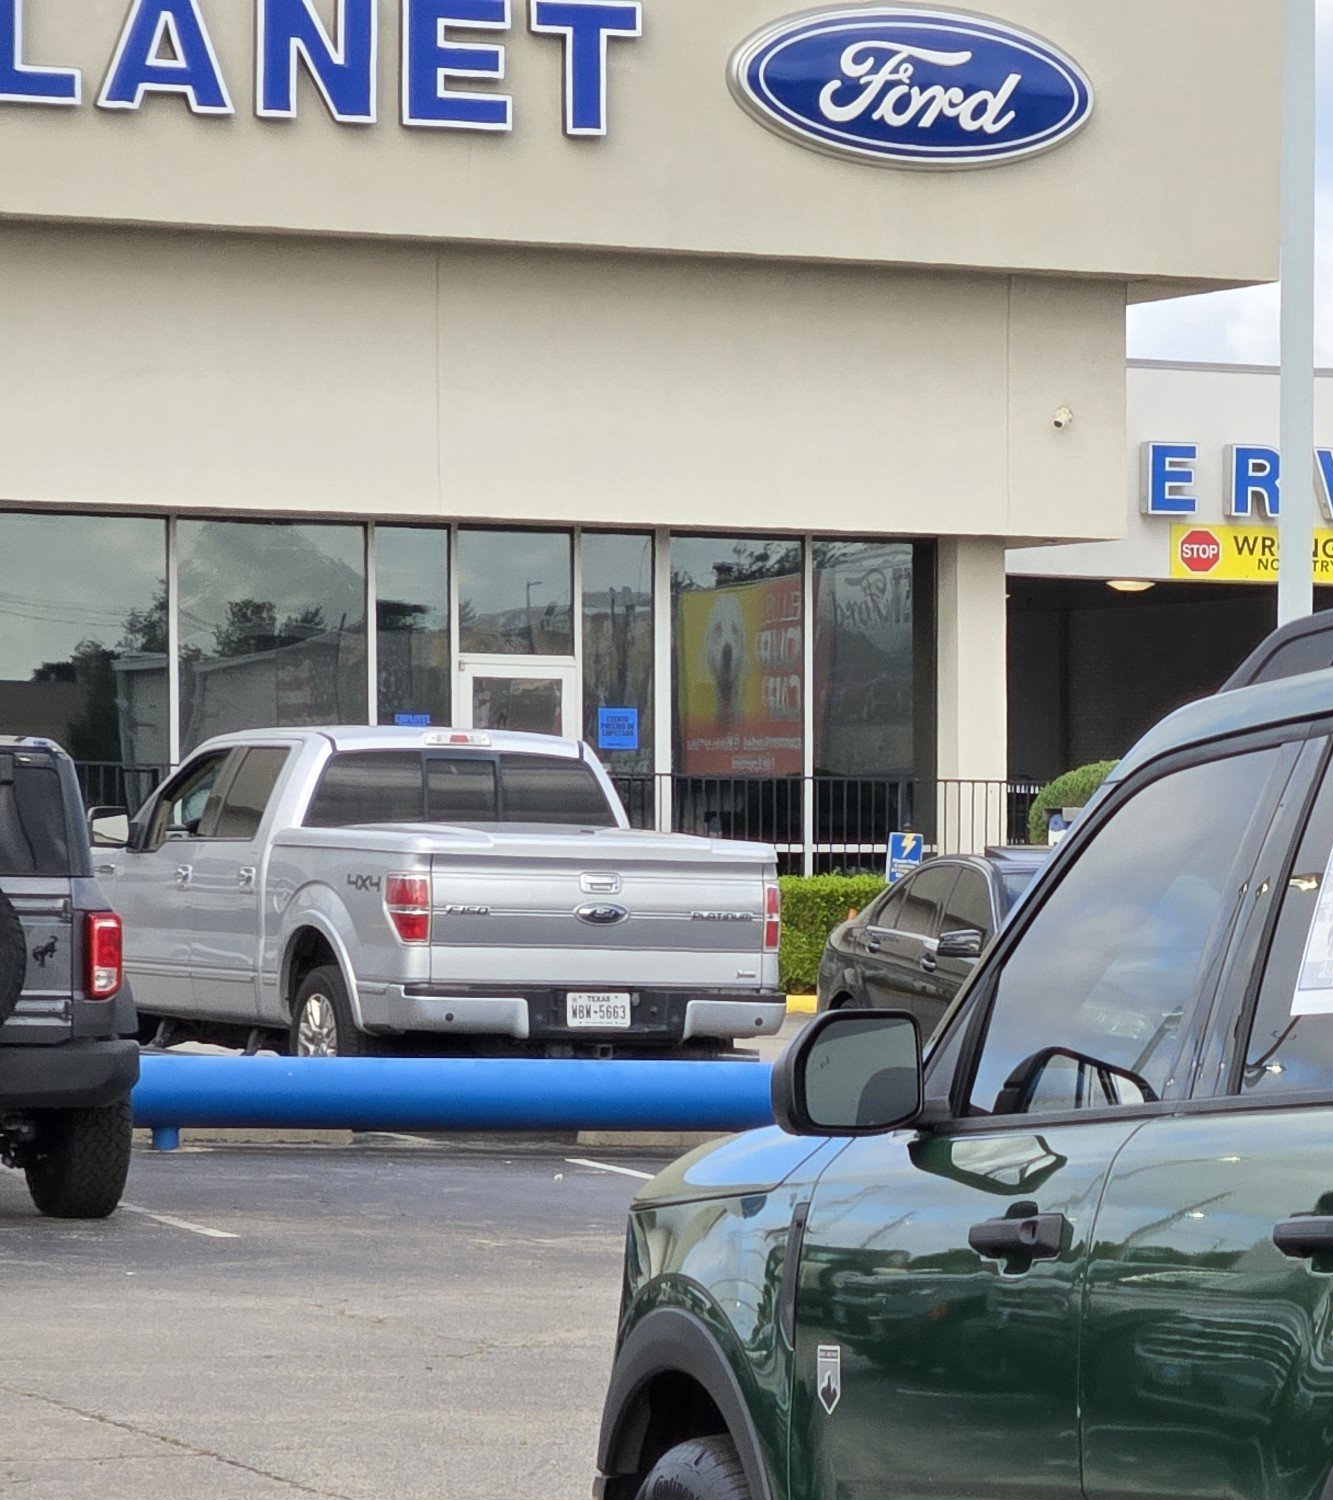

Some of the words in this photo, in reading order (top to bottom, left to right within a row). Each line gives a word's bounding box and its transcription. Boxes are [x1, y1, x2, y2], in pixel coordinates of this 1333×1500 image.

[0, 0, 643, 137] LANET
[819, 40, 1022, 135] Ford
[1182, 544, 1218, 559] STOP
[347, 874, 382, 891] 4X4
